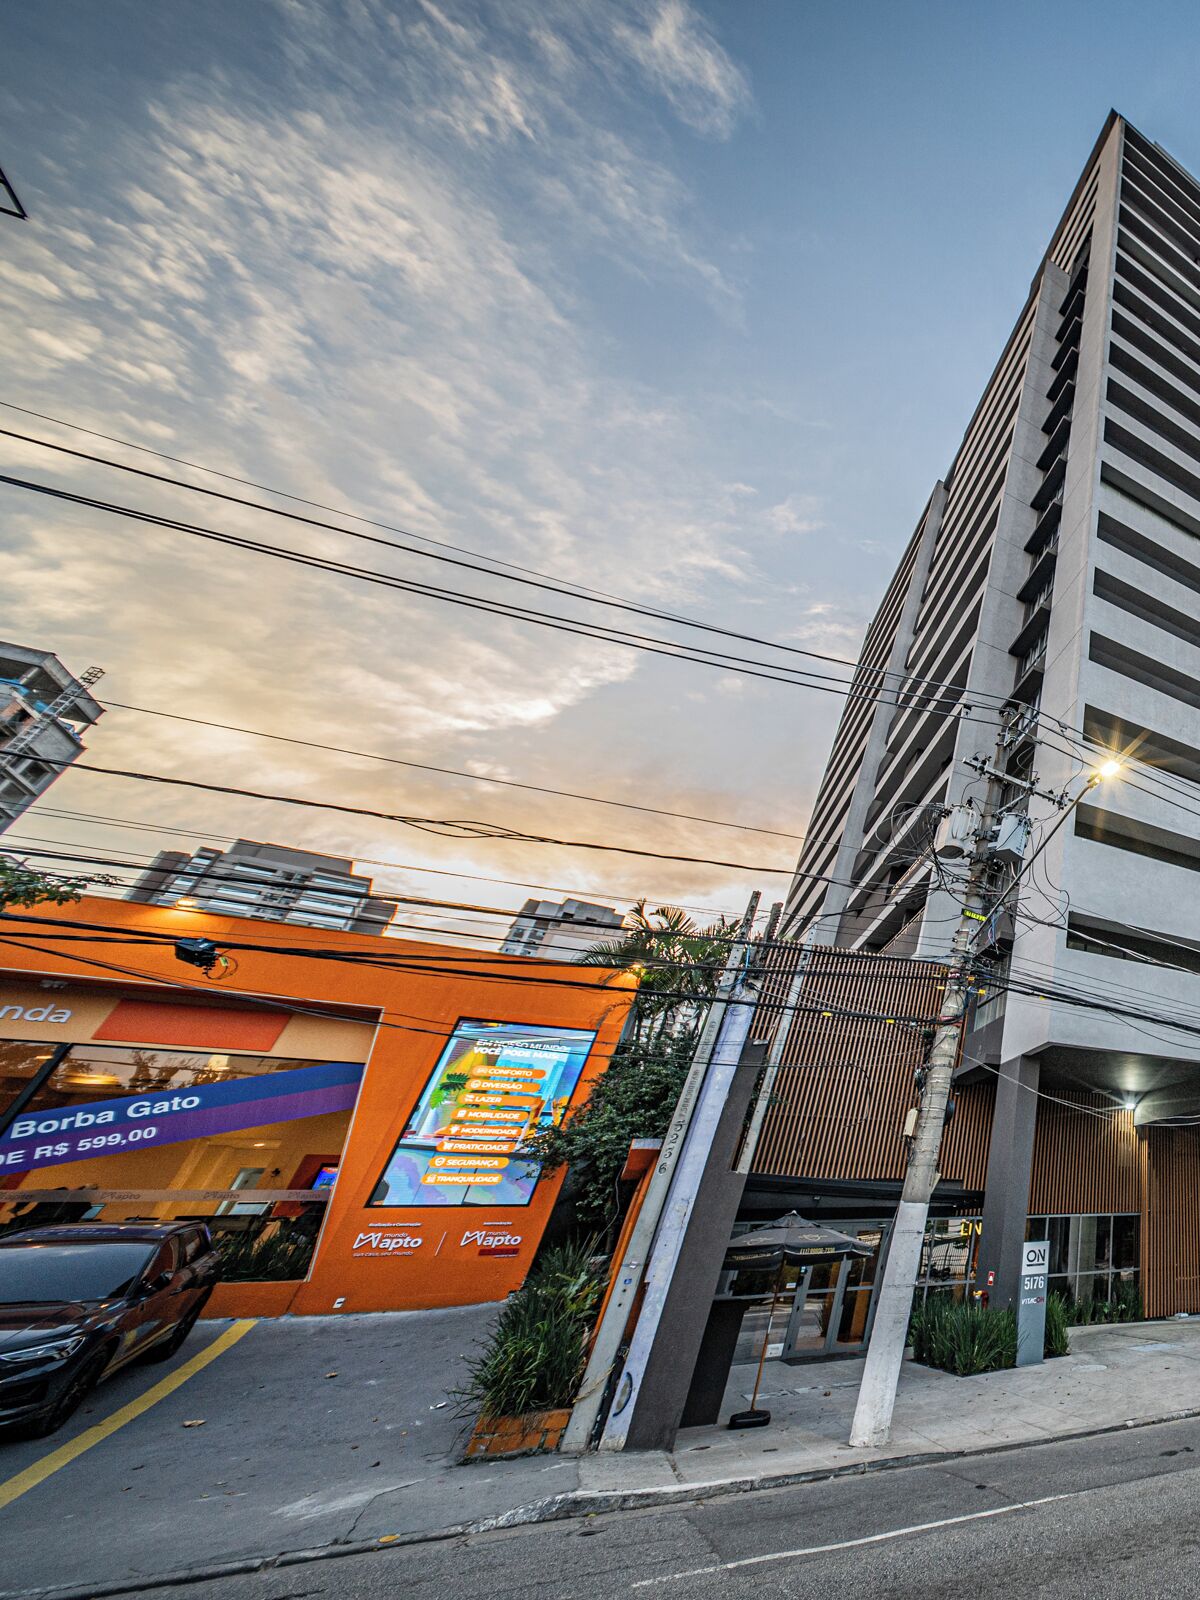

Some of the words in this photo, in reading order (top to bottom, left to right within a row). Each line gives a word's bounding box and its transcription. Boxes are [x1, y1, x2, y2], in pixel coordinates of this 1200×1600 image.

[503, 1048, 532, 1058] PODE
[488, 1067, 533, 1077] CONFORTO
[481, 1080, 523, 1090] DIVERSÃO
[10, 1109, 115, 1139] Borba
[126, 1096, 201, 1118] Gato
[467, 1110, 521, 1120] MOBILIDADE
[460, 1127, 518, 1135] MODERNIDADE
[33, 1142, 70, 1160] R$
[77, 1126, 157, 1152] 599,00
[453, 1142, 510, 1151] PRATICIDADE
[445, 1158, 499, 1167] SEGURANÇA
[436, 1175, 500, 1183] TRANQUILIDADE
[1026, 1249, 1046, 1263] ON
[1024, 1275, 1045, 1290] 5176
